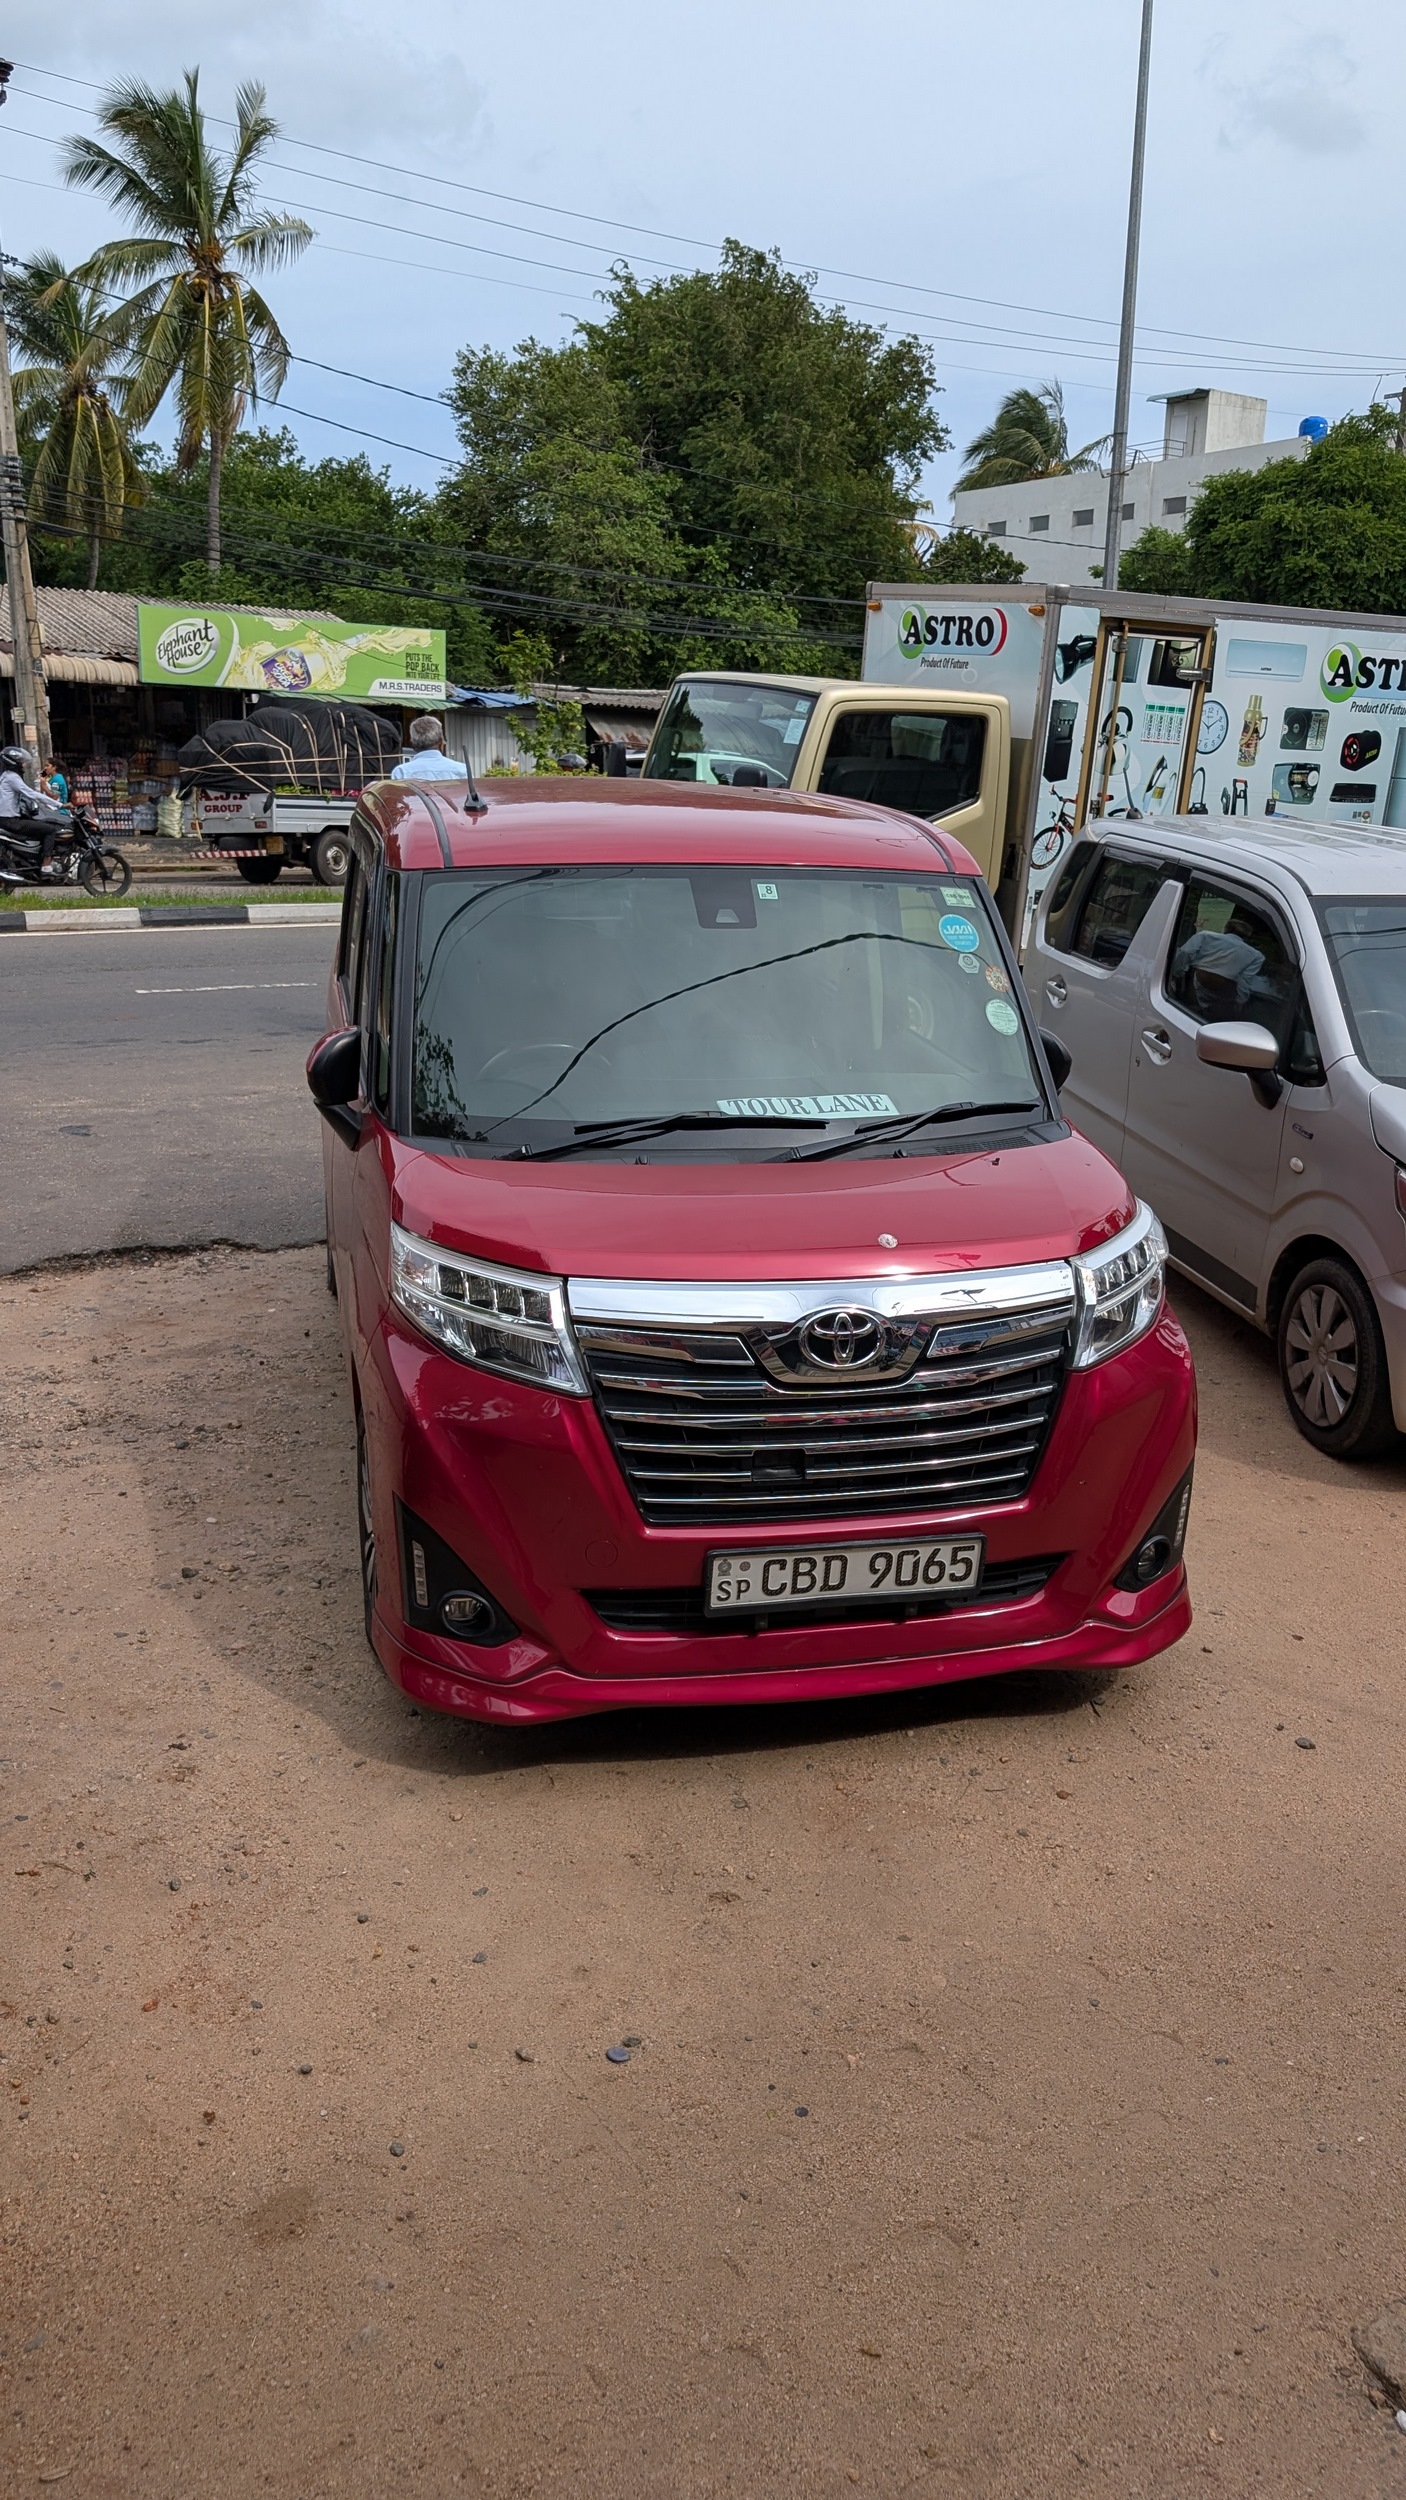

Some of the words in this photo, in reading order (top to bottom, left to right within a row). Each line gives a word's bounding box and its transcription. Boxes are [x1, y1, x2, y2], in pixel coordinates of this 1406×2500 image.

[157, 618, 215, 660] Elephant
[903, 615, 995, 647] ASTRO
[166, 641, 203, 668] House
[405, 652, 420, 661] PUTS
[421, 654, 433, 662] THE
[920, 656, 942, 668] Product
[942, 657, 951, 668] Of
[949, 658, 969, 669] Future
[405, 661, 420, 671] POP
[421, 662, 440, 673] BACK
[1349, 700, 1379, 714] Product
[1379, 702, 1390, 715] Of
[204, 804, 243, 813] GROUP
[765, 885, 773, 895] 8
[727, 1098, 811, 1116] TOUR
[808, 1094, 890, 1114] LANE
[761, 1554, 848, 1597] CBD
[868, 1544, 976, 1589] 9065
[716, 1578, 751, 1602] SP
